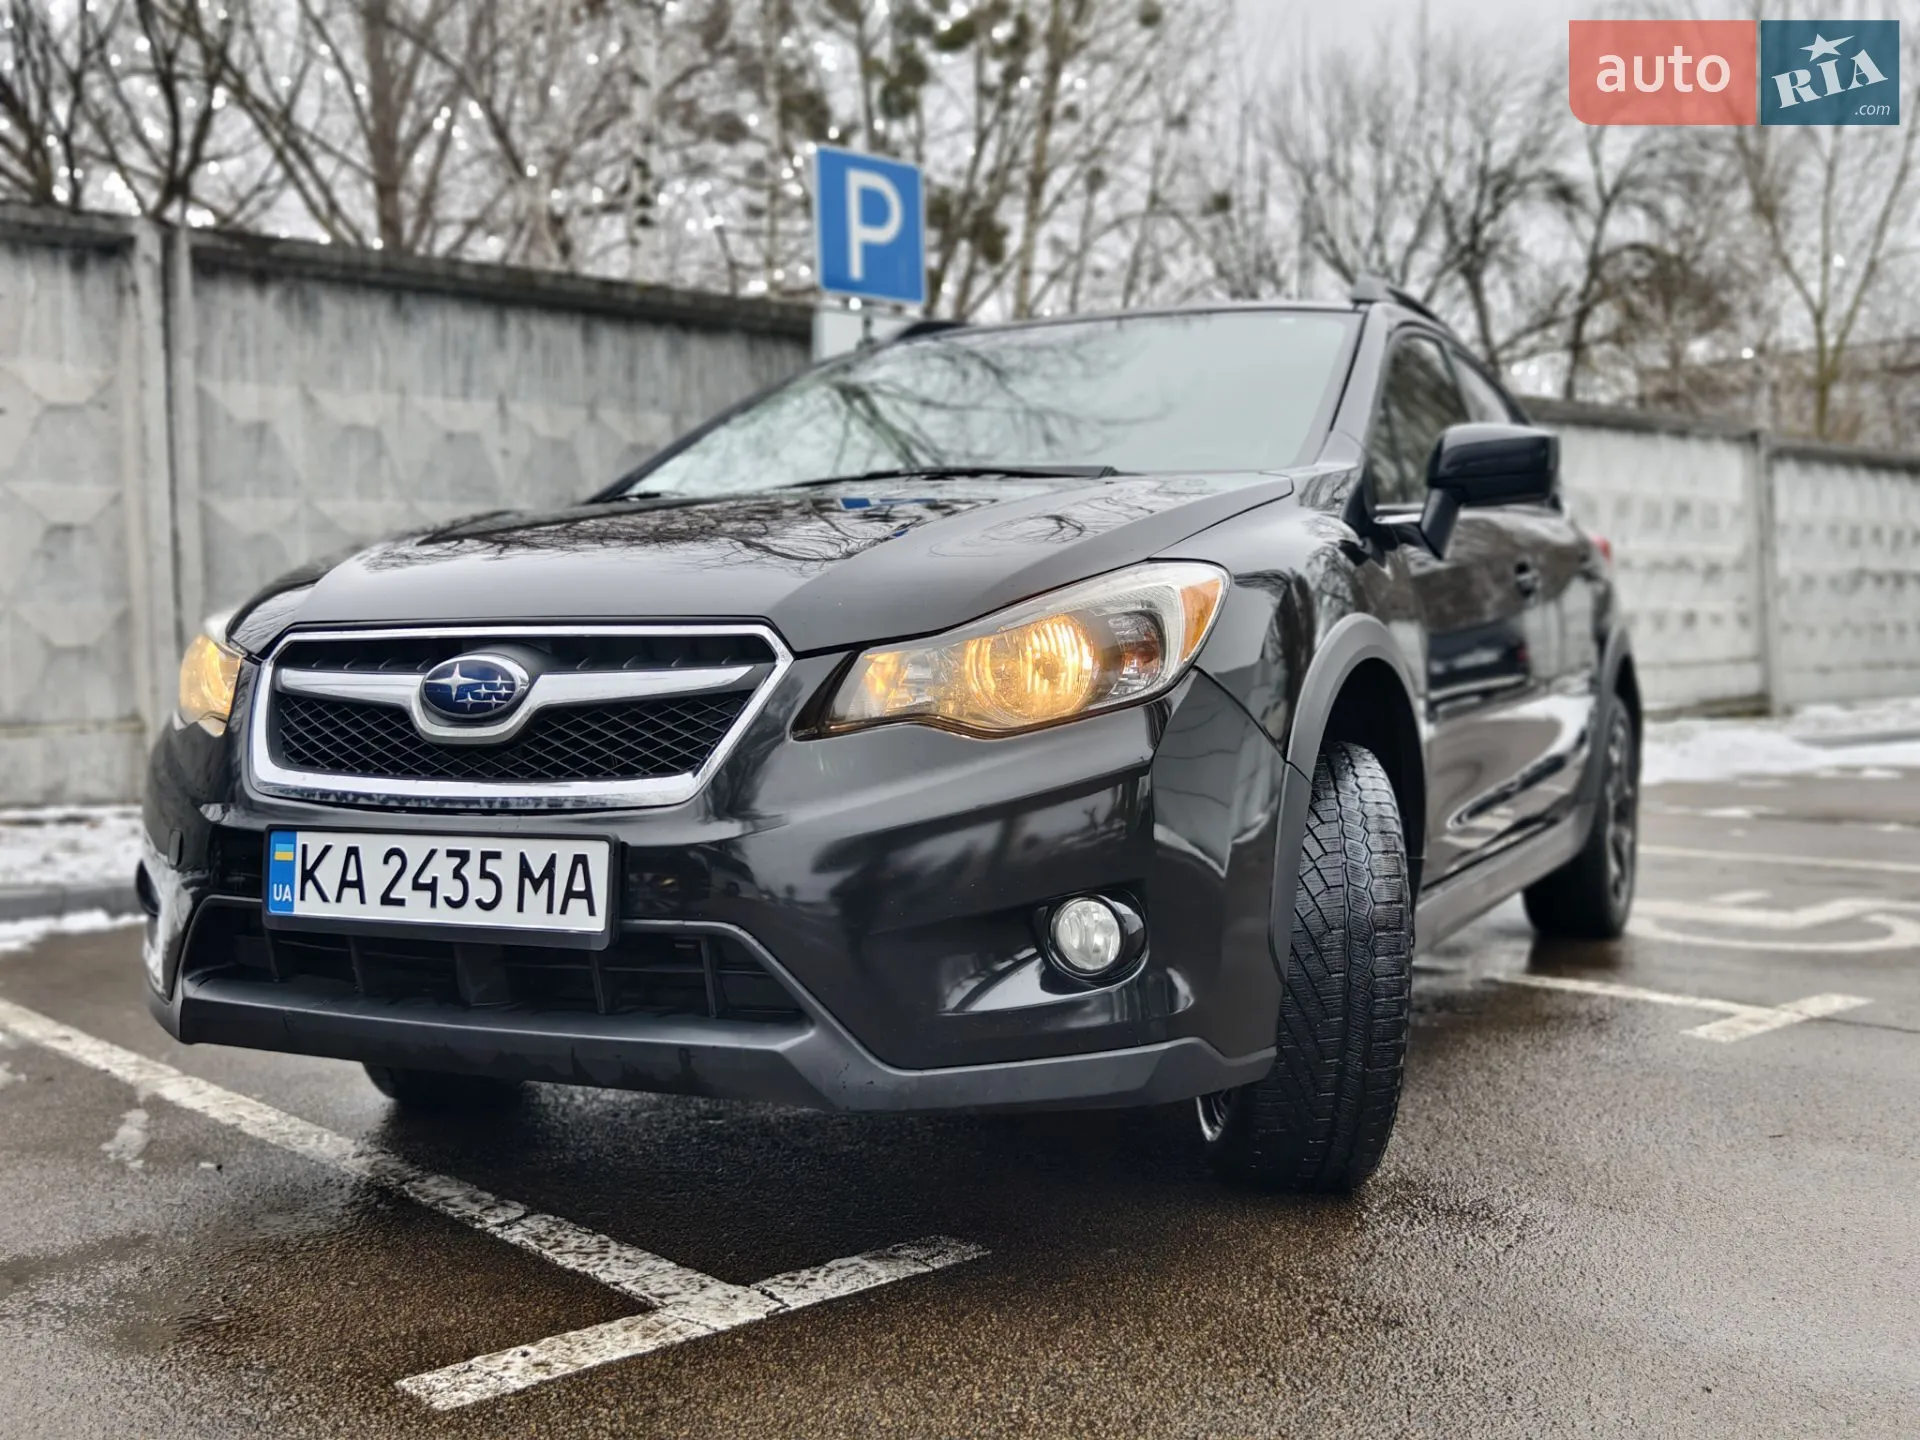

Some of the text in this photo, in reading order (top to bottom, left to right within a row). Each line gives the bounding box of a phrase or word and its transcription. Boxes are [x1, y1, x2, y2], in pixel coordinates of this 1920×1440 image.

[846, 167, 904, 282] P
[273, 884, 292, 902] UA
[299, 843, 597, 917] KA 2435 MA
